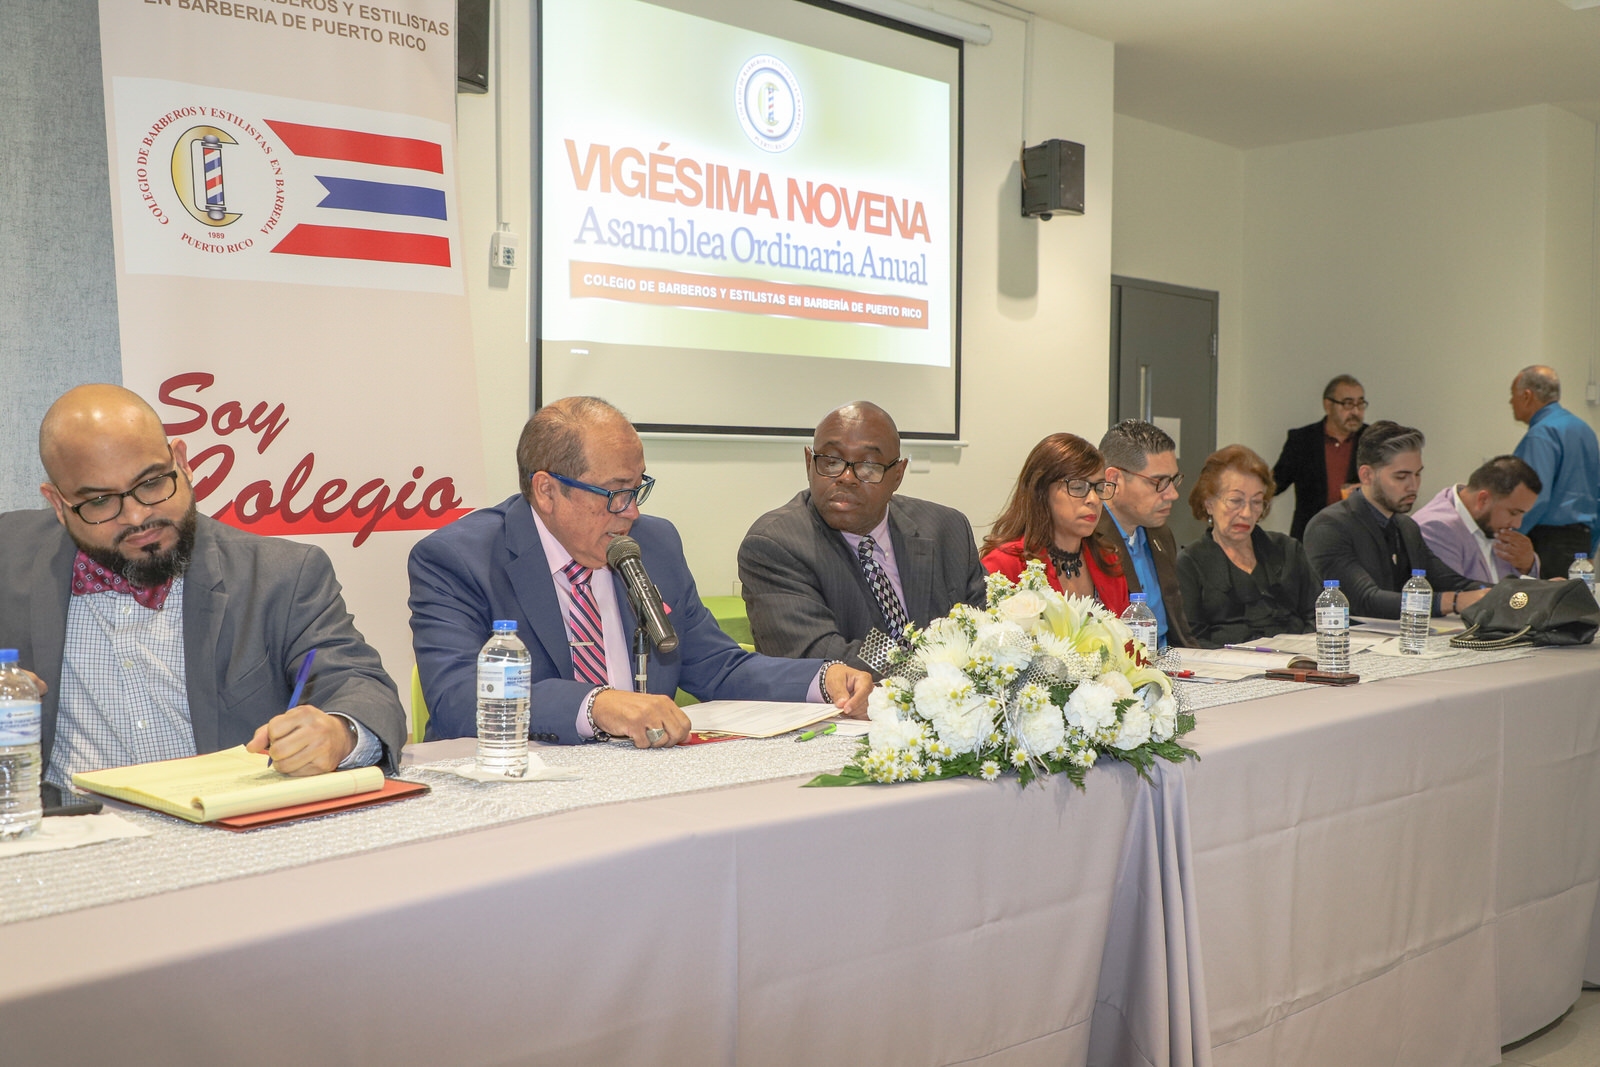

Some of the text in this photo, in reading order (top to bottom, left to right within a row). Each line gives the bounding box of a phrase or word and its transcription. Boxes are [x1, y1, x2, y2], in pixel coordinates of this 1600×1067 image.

[178, 0, 426, 52] BARBERIA DE PUERTO RICO
[343, 2, 354, 16] Y
[359, 5, 449, 36] ESTILISTAS
[137, 106, 285, 235] COLEGIO DE BARBEROS Y ESTILISTAS EN BARBERIA
[564, 138, 931, 243] VIGÉSIMA NOVENA
[181, 232, 254, 254] PUERTO RICO
[574, 206, 928, 286] Asamblea Ordinaria Anual
[583, 273, 922, 319] COLEGIO DE BARBEROS Y ESTILISTAS EN BARBERÍA DE PUERTO RICO
[158, 372, 290, 455] Soy
